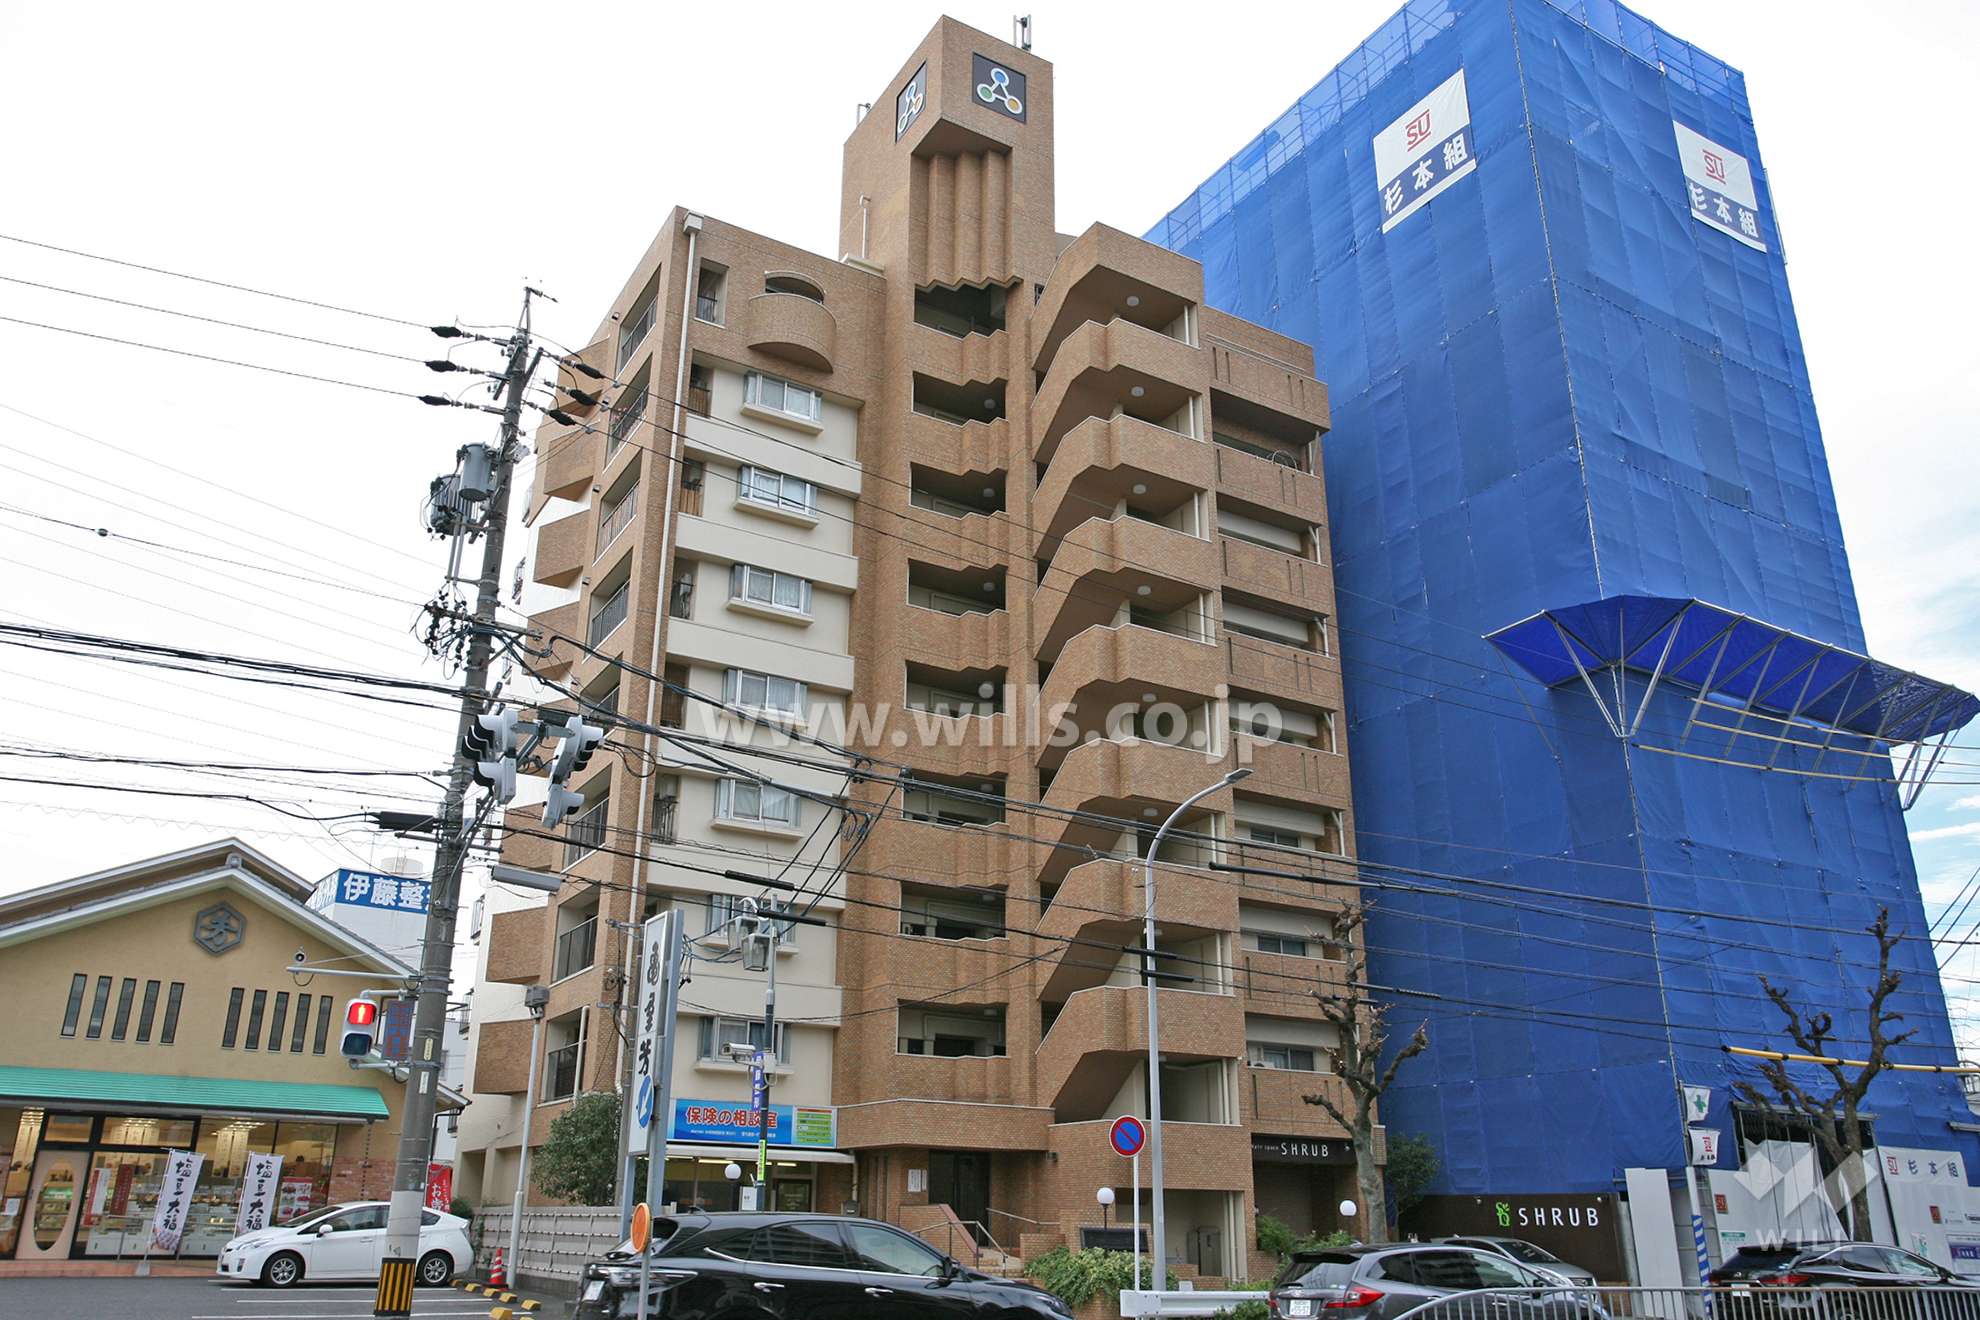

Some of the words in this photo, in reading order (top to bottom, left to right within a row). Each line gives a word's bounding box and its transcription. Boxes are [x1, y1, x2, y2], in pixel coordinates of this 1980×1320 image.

[1384, 143, 1467, 214] 杉本組
[1689, 182, 1758, 238] 杉本組
[344, 872, 431, 910] 伊藤整
[1281, 1142, 1329, 1157] SHRUB
[164, 1158, 193, 1231] 塩豆大福
[246, 1159, 273, 1231] 塩豆大福
[1518, 1207, 1599, 1226] SHRUB
